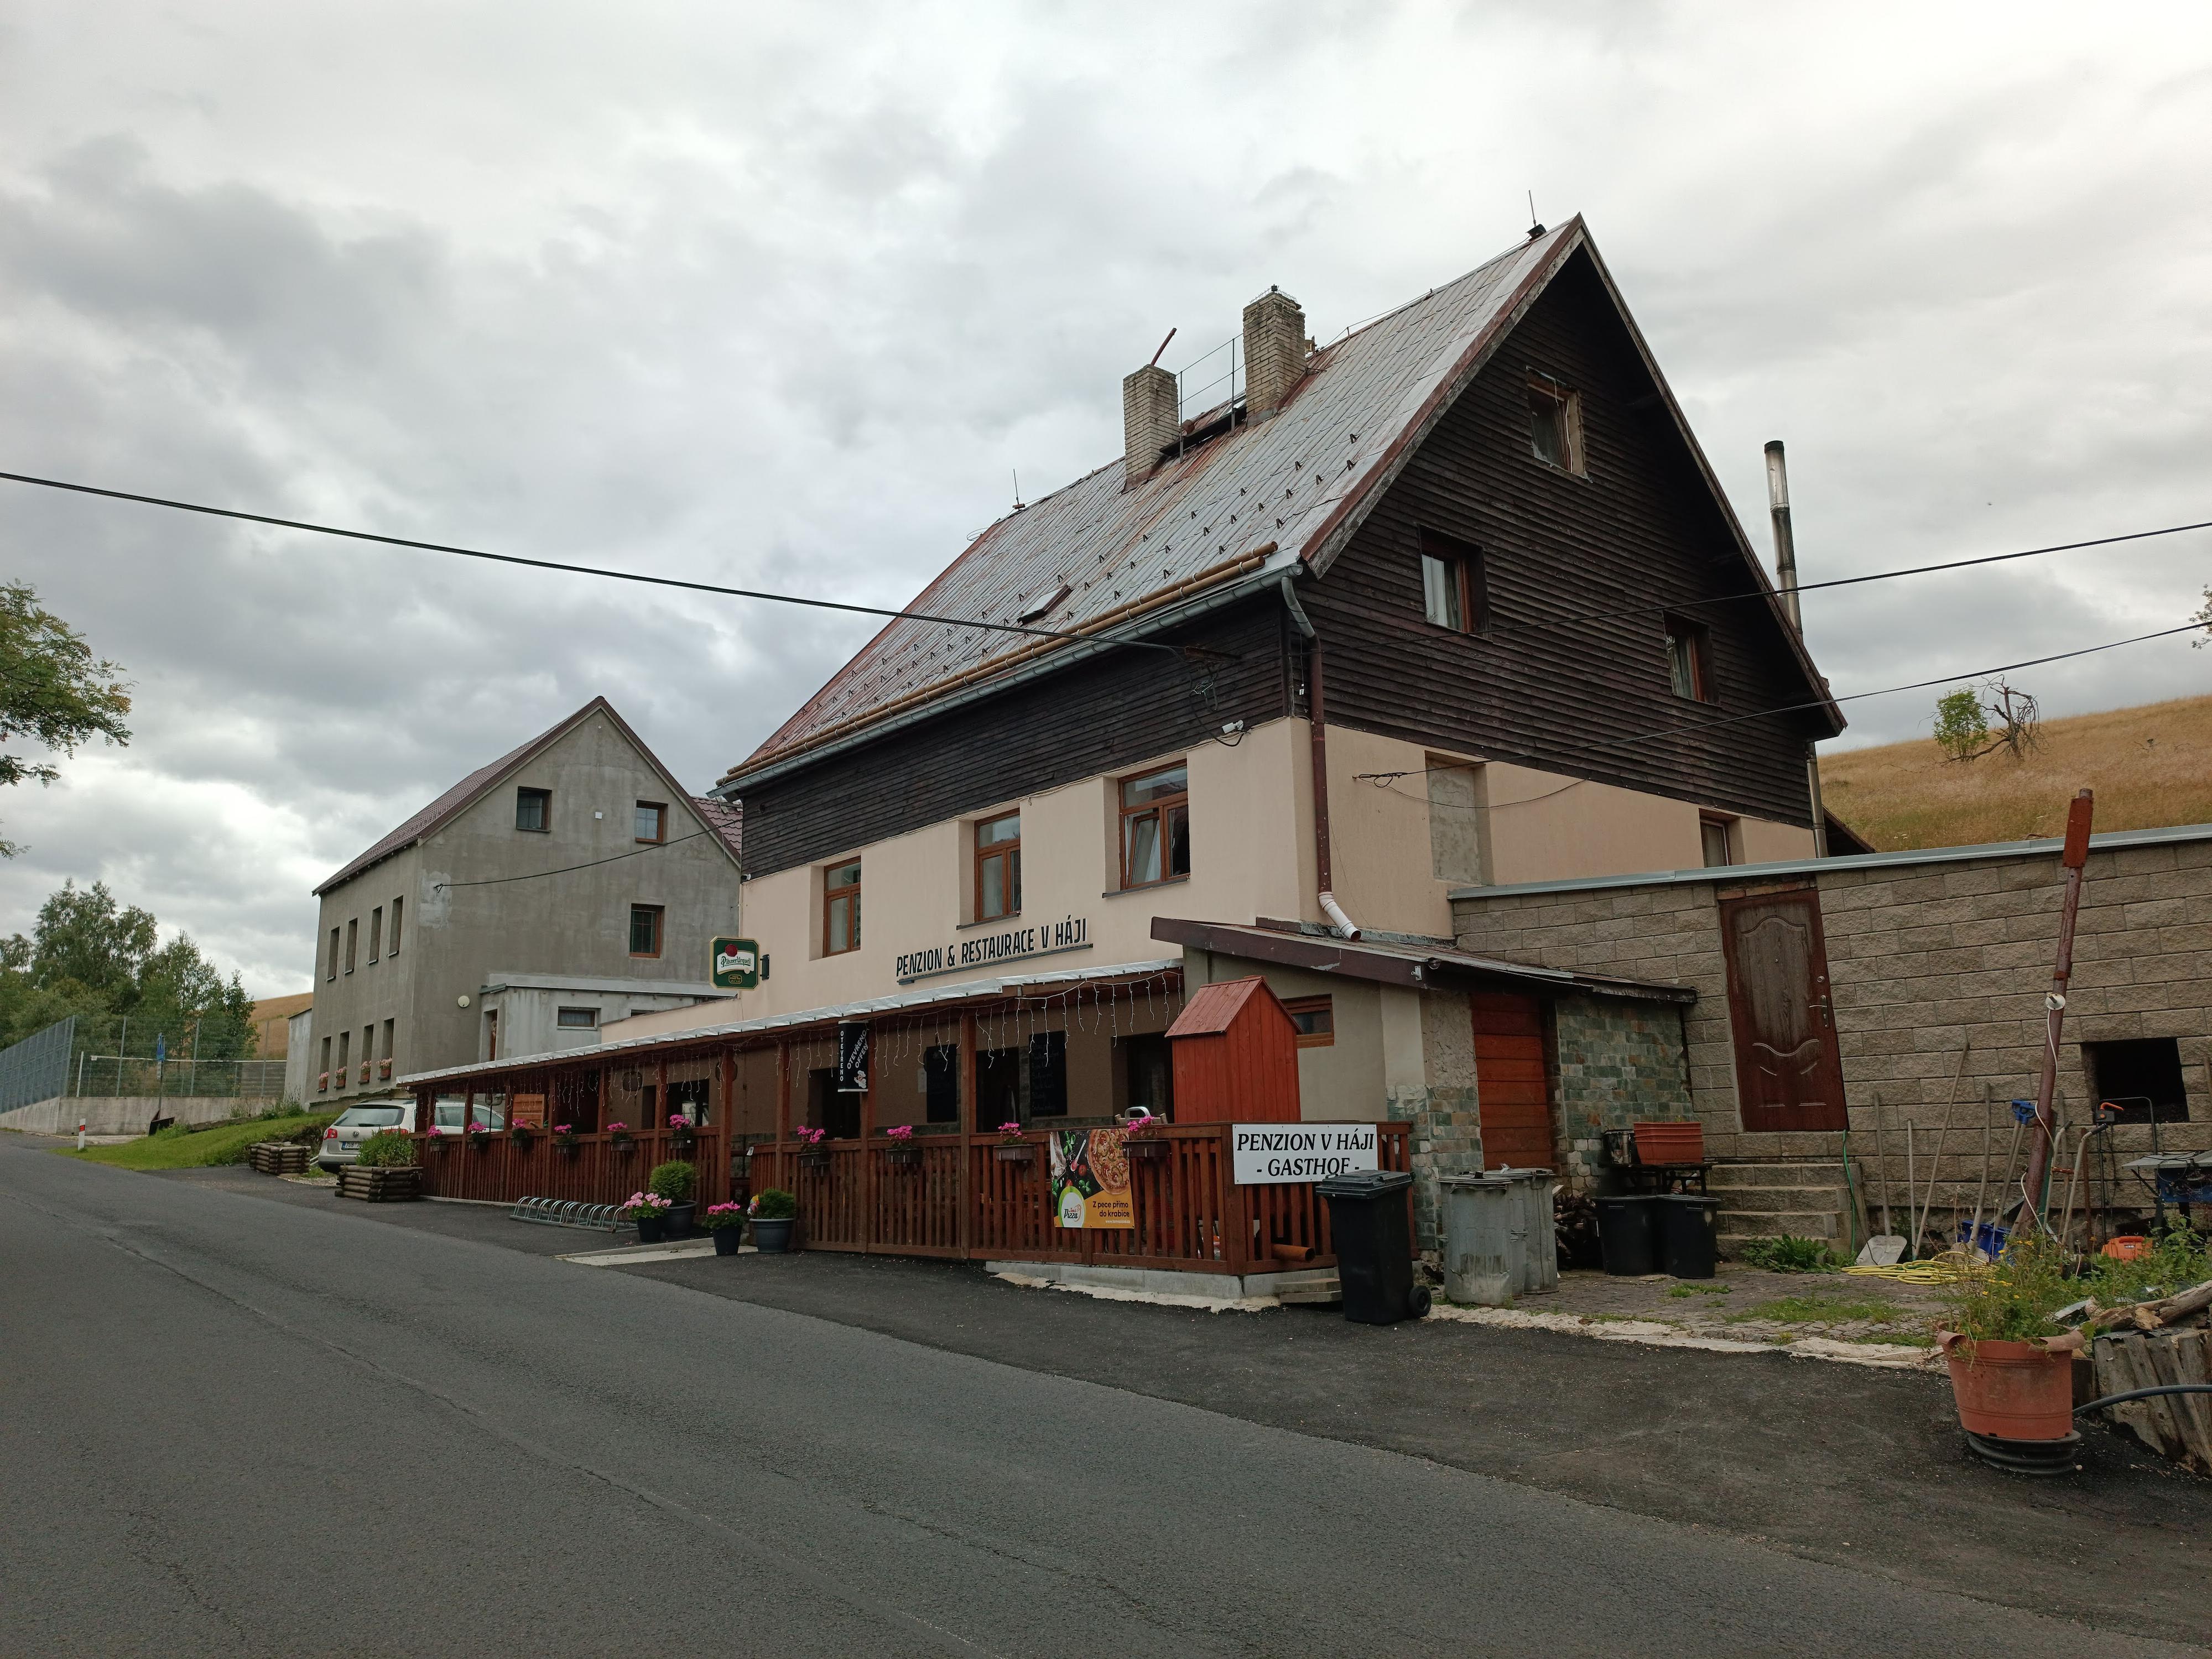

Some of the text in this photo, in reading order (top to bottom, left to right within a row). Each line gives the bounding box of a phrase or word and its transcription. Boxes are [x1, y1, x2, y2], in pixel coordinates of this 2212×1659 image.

[896, 915, 1086, 977] PENZION & RESTAURACE V HÁJI
[721, 956, 751, 968] Pilsner Urquell
[855, 1042, 868, 1068] OFFEN
[1237, 1128, 1374, 1151] PENZION V HÁJI
[1268, 1157, 1350, 1176] GASTHOF
[1064, 1208, 1079, 1218] Pizza
